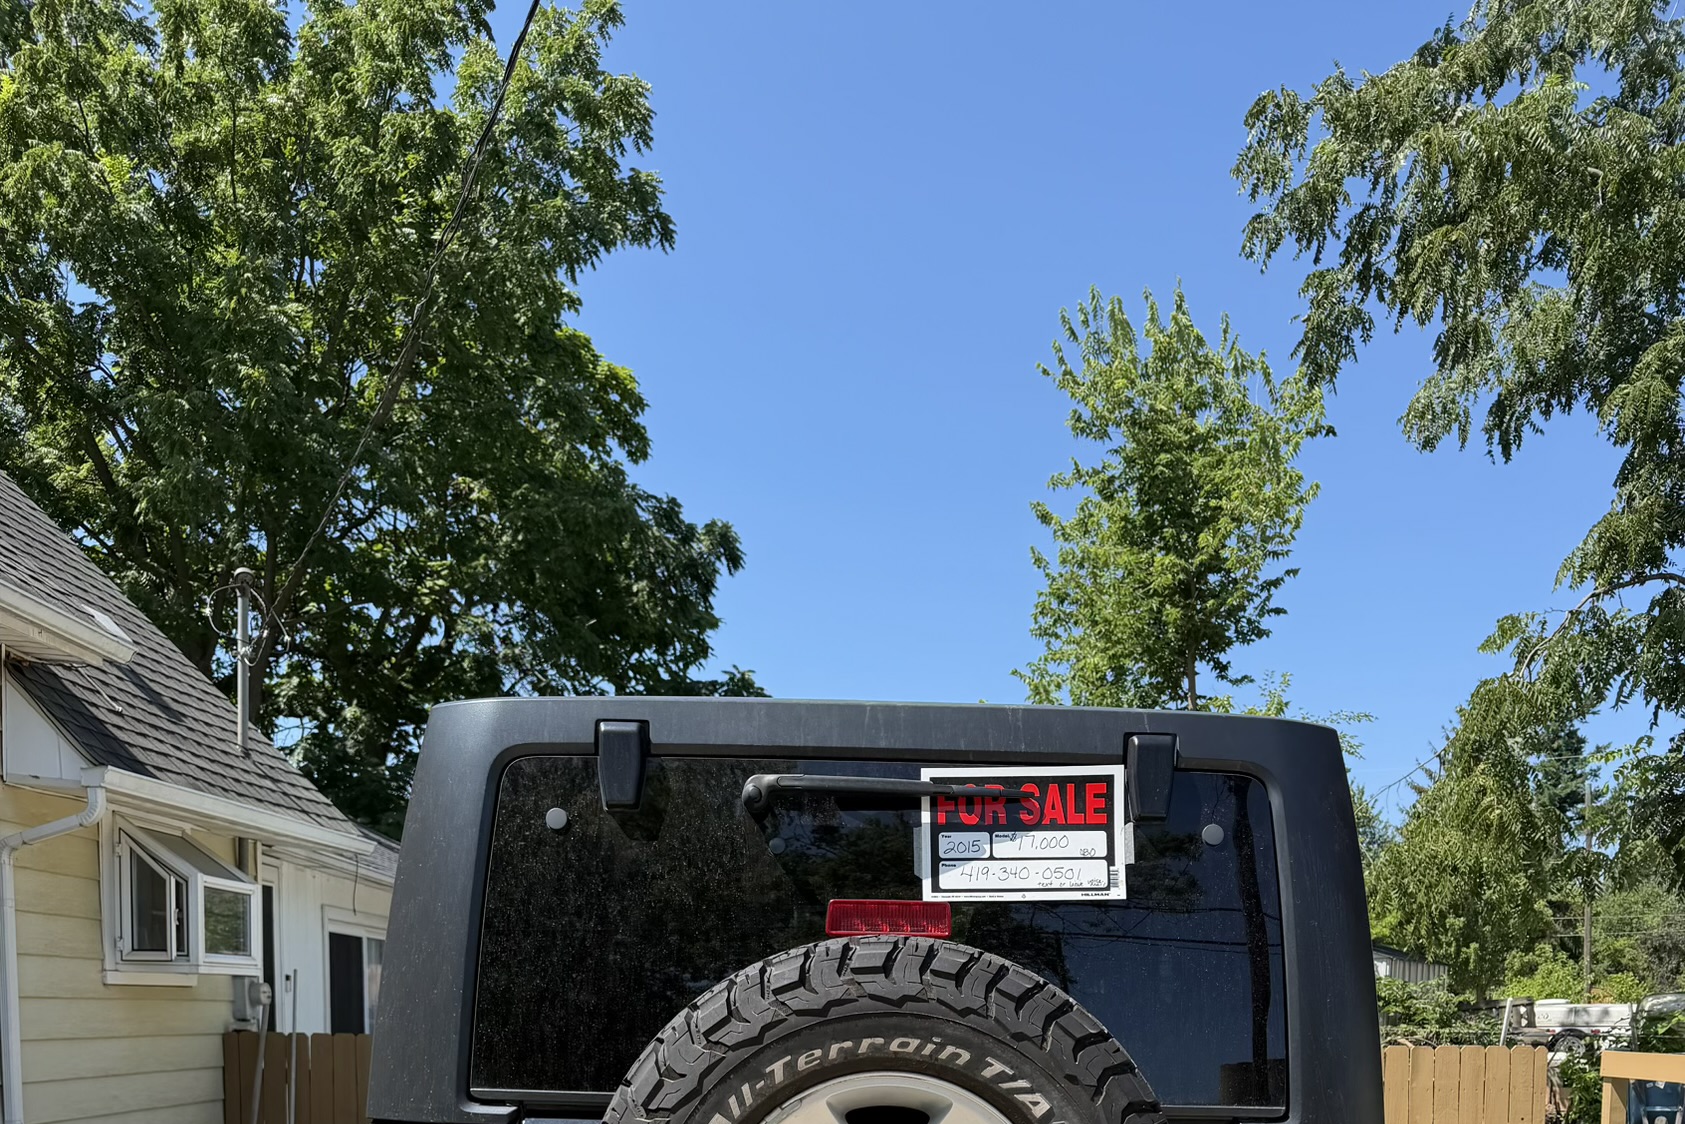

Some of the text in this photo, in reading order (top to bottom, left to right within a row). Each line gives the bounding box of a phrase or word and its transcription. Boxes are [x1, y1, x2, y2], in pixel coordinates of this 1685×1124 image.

[937, 783, 1107, 825] FOR SALE
[943, 839, 981, 854] 2015
[979, 1056, 1054, 1121] T/A
